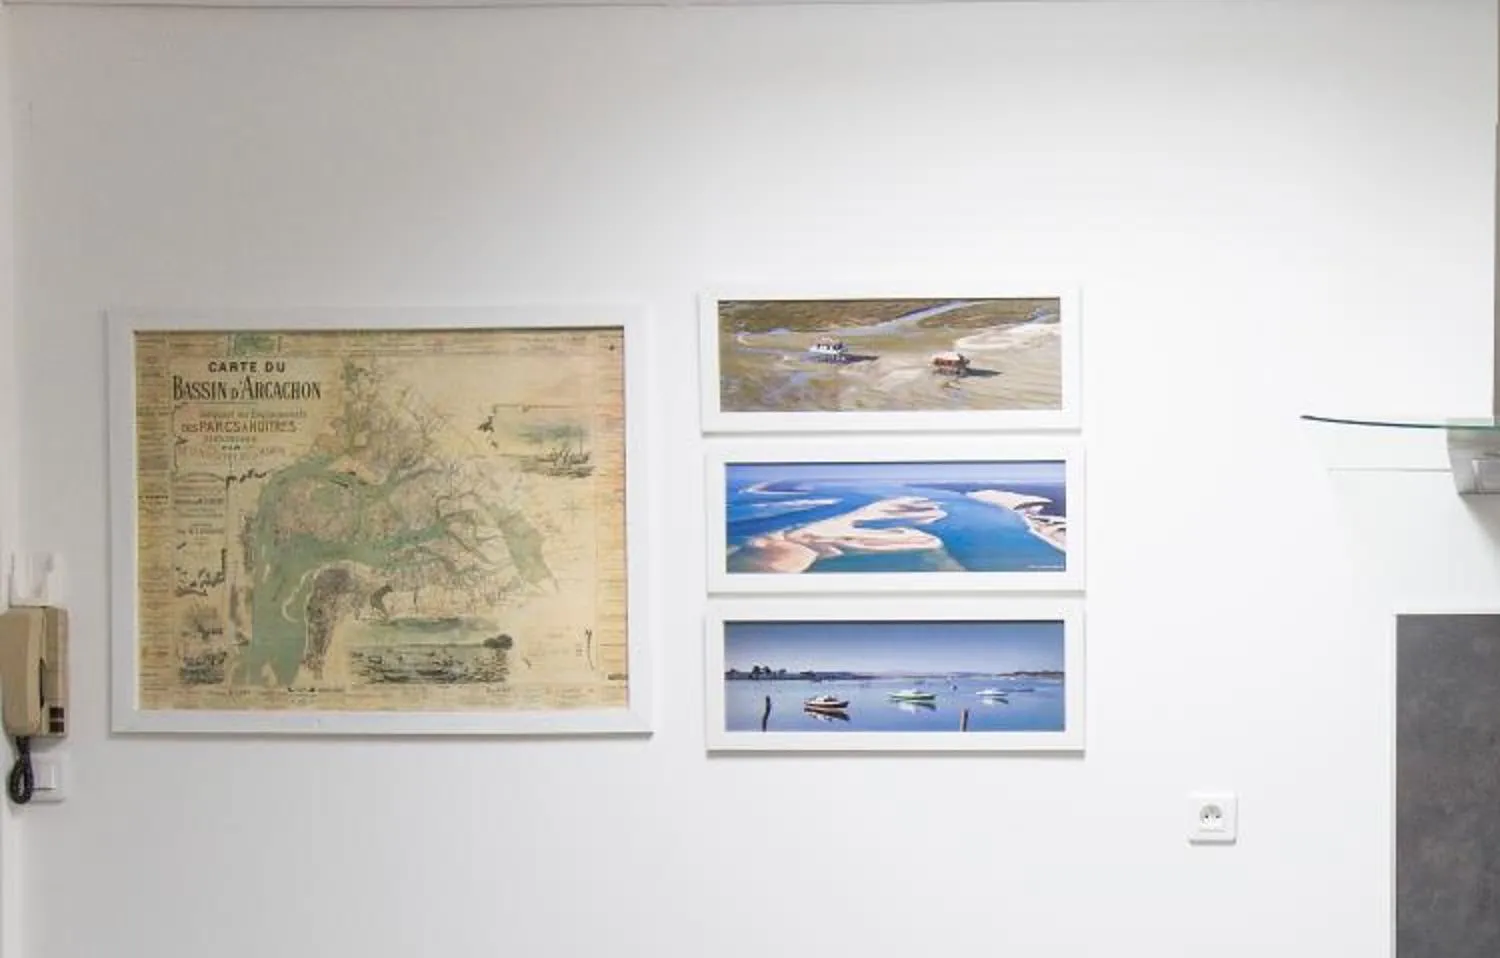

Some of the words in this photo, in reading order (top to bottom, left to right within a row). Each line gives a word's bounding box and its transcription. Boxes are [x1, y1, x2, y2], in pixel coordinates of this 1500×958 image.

[208, 361, 257, 373] CARTE
[265, 361, 286, 373] DU
[172, 375, 228, 400] BASSIN
